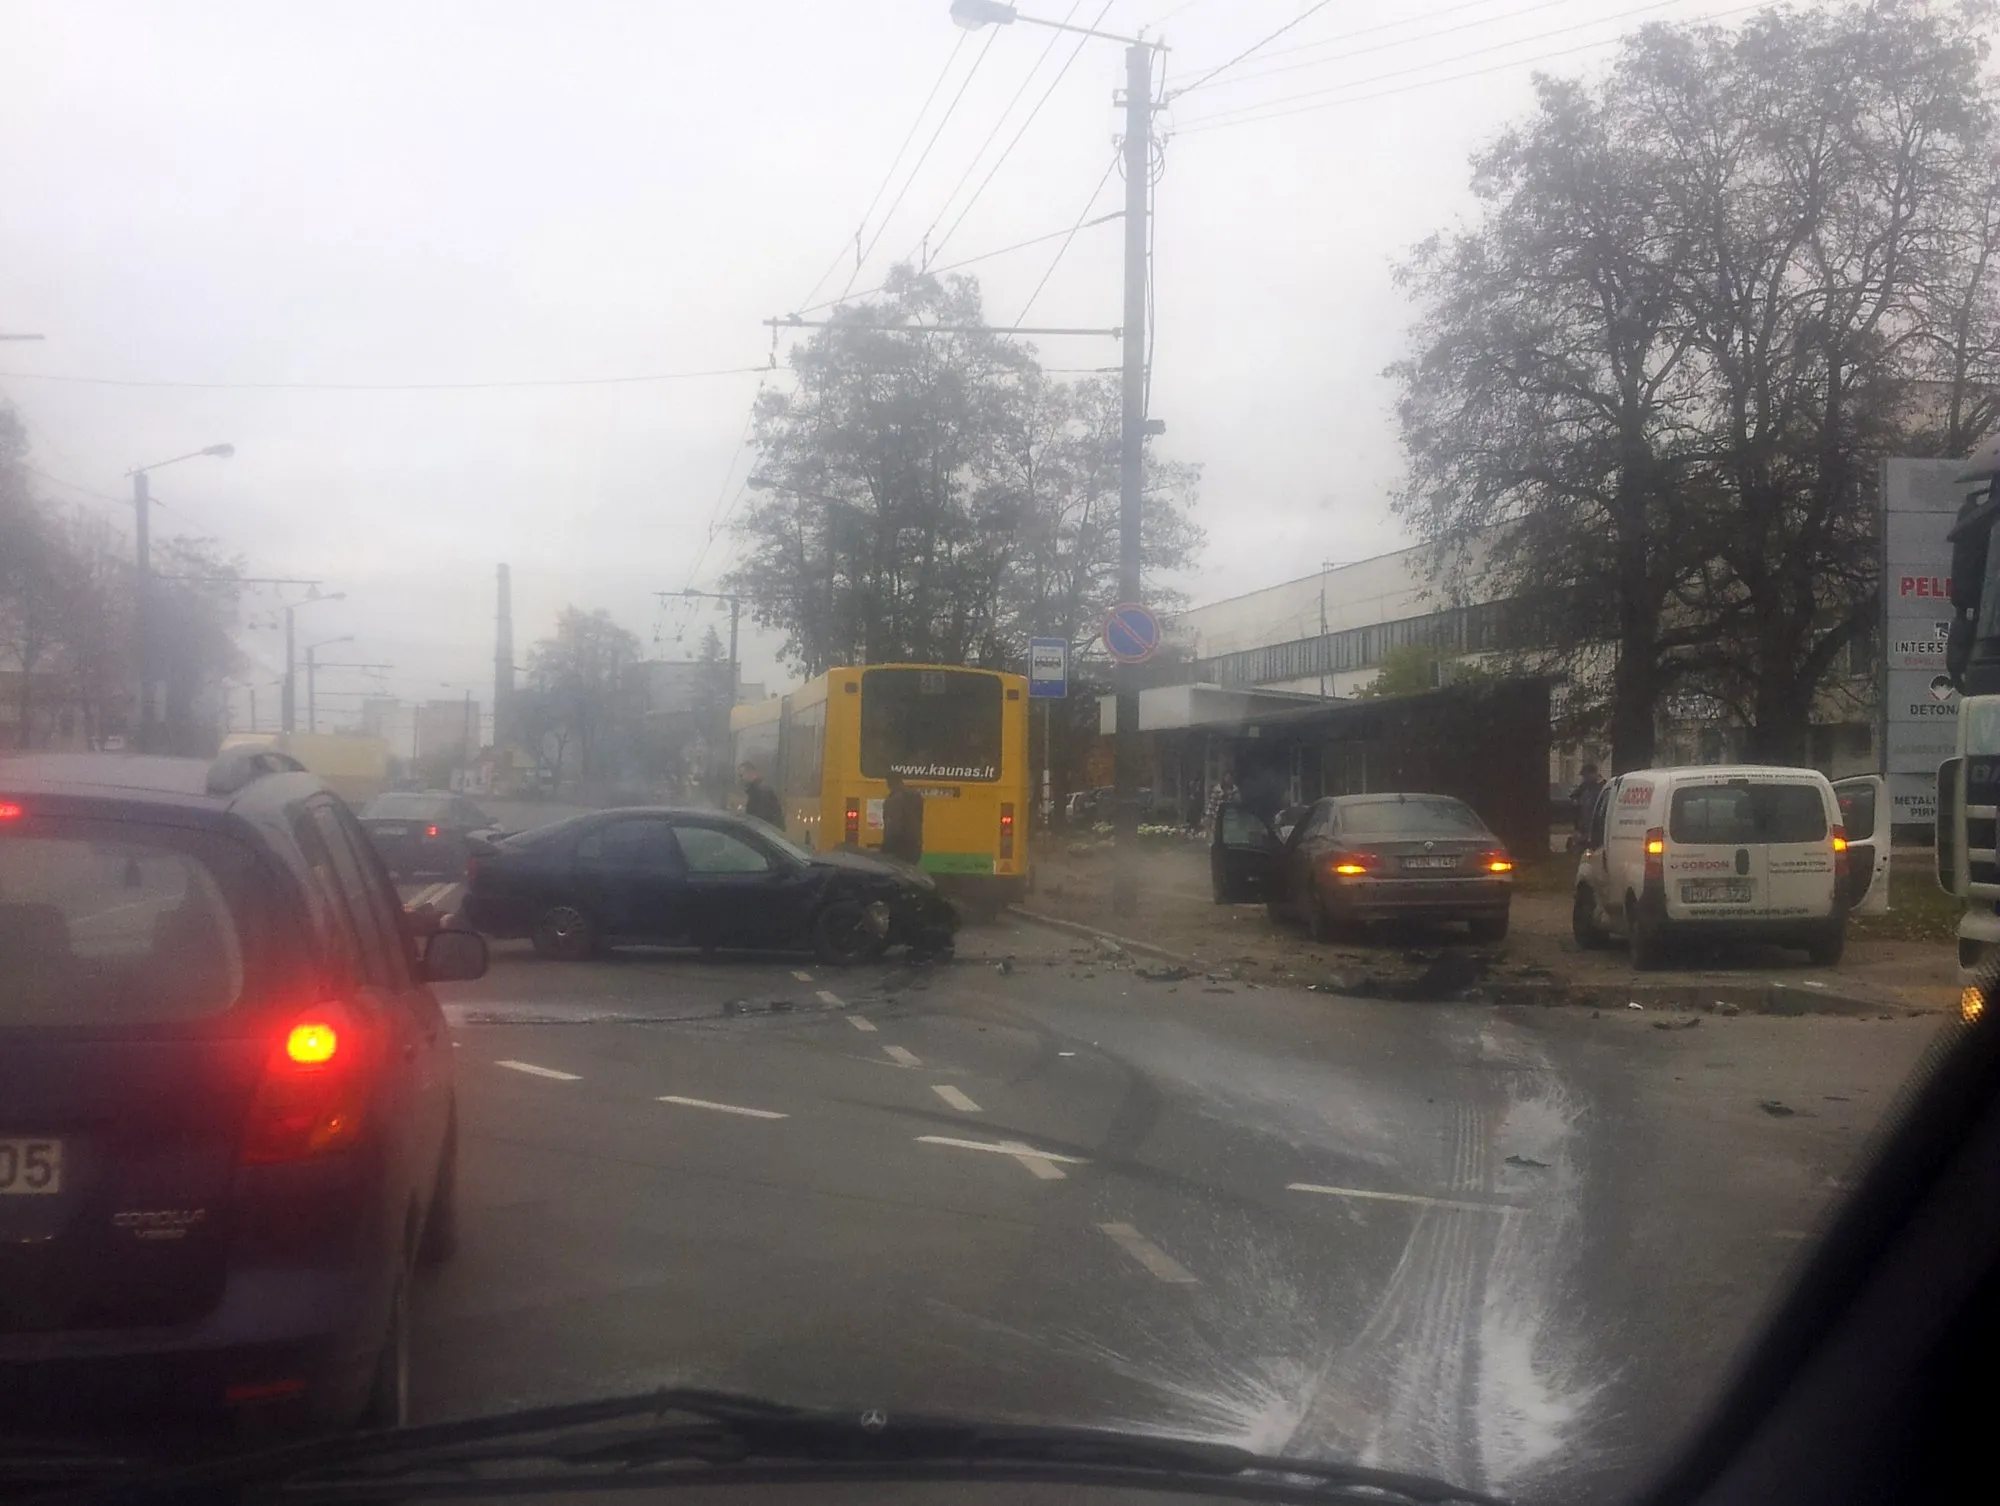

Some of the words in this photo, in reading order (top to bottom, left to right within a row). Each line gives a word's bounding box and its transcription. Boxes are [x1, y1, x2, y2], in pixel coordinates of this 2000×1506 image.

[889, 763, 995, 778] www.kaunas.lt
[1681, 861, 1729, 869] GORDON
[0, 1143, 51, 1189] 05
